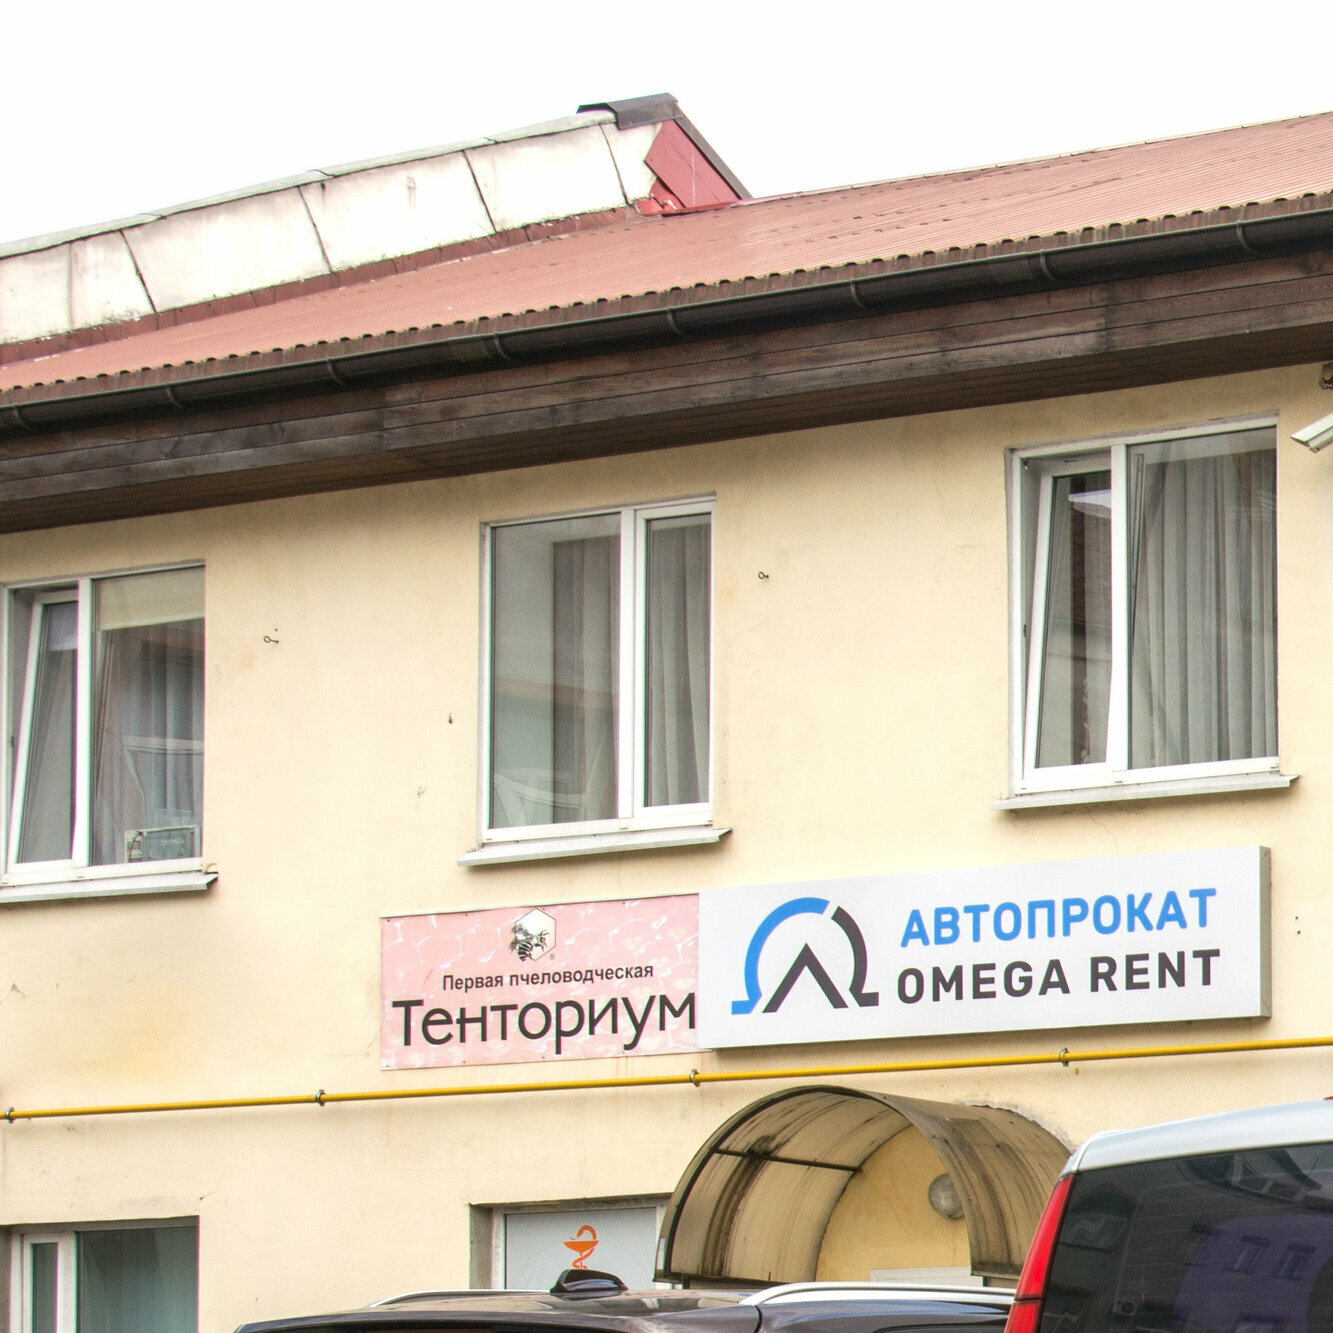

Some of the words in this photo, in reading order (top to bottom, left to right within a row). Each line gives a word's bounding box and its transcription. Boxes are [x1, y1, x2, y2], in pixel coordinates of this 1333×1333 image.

[900, 887, 1217, 948] АВТОПРОКАТ
[443, 973, 503, 992] Первая
[509, 965, 653, 986] пчеловодческая
[897, 958, 1070, 1004] OMEGA
[1089, 948, 1220, 993] RENT
[392, 992, 696, 1055] Тенториум
